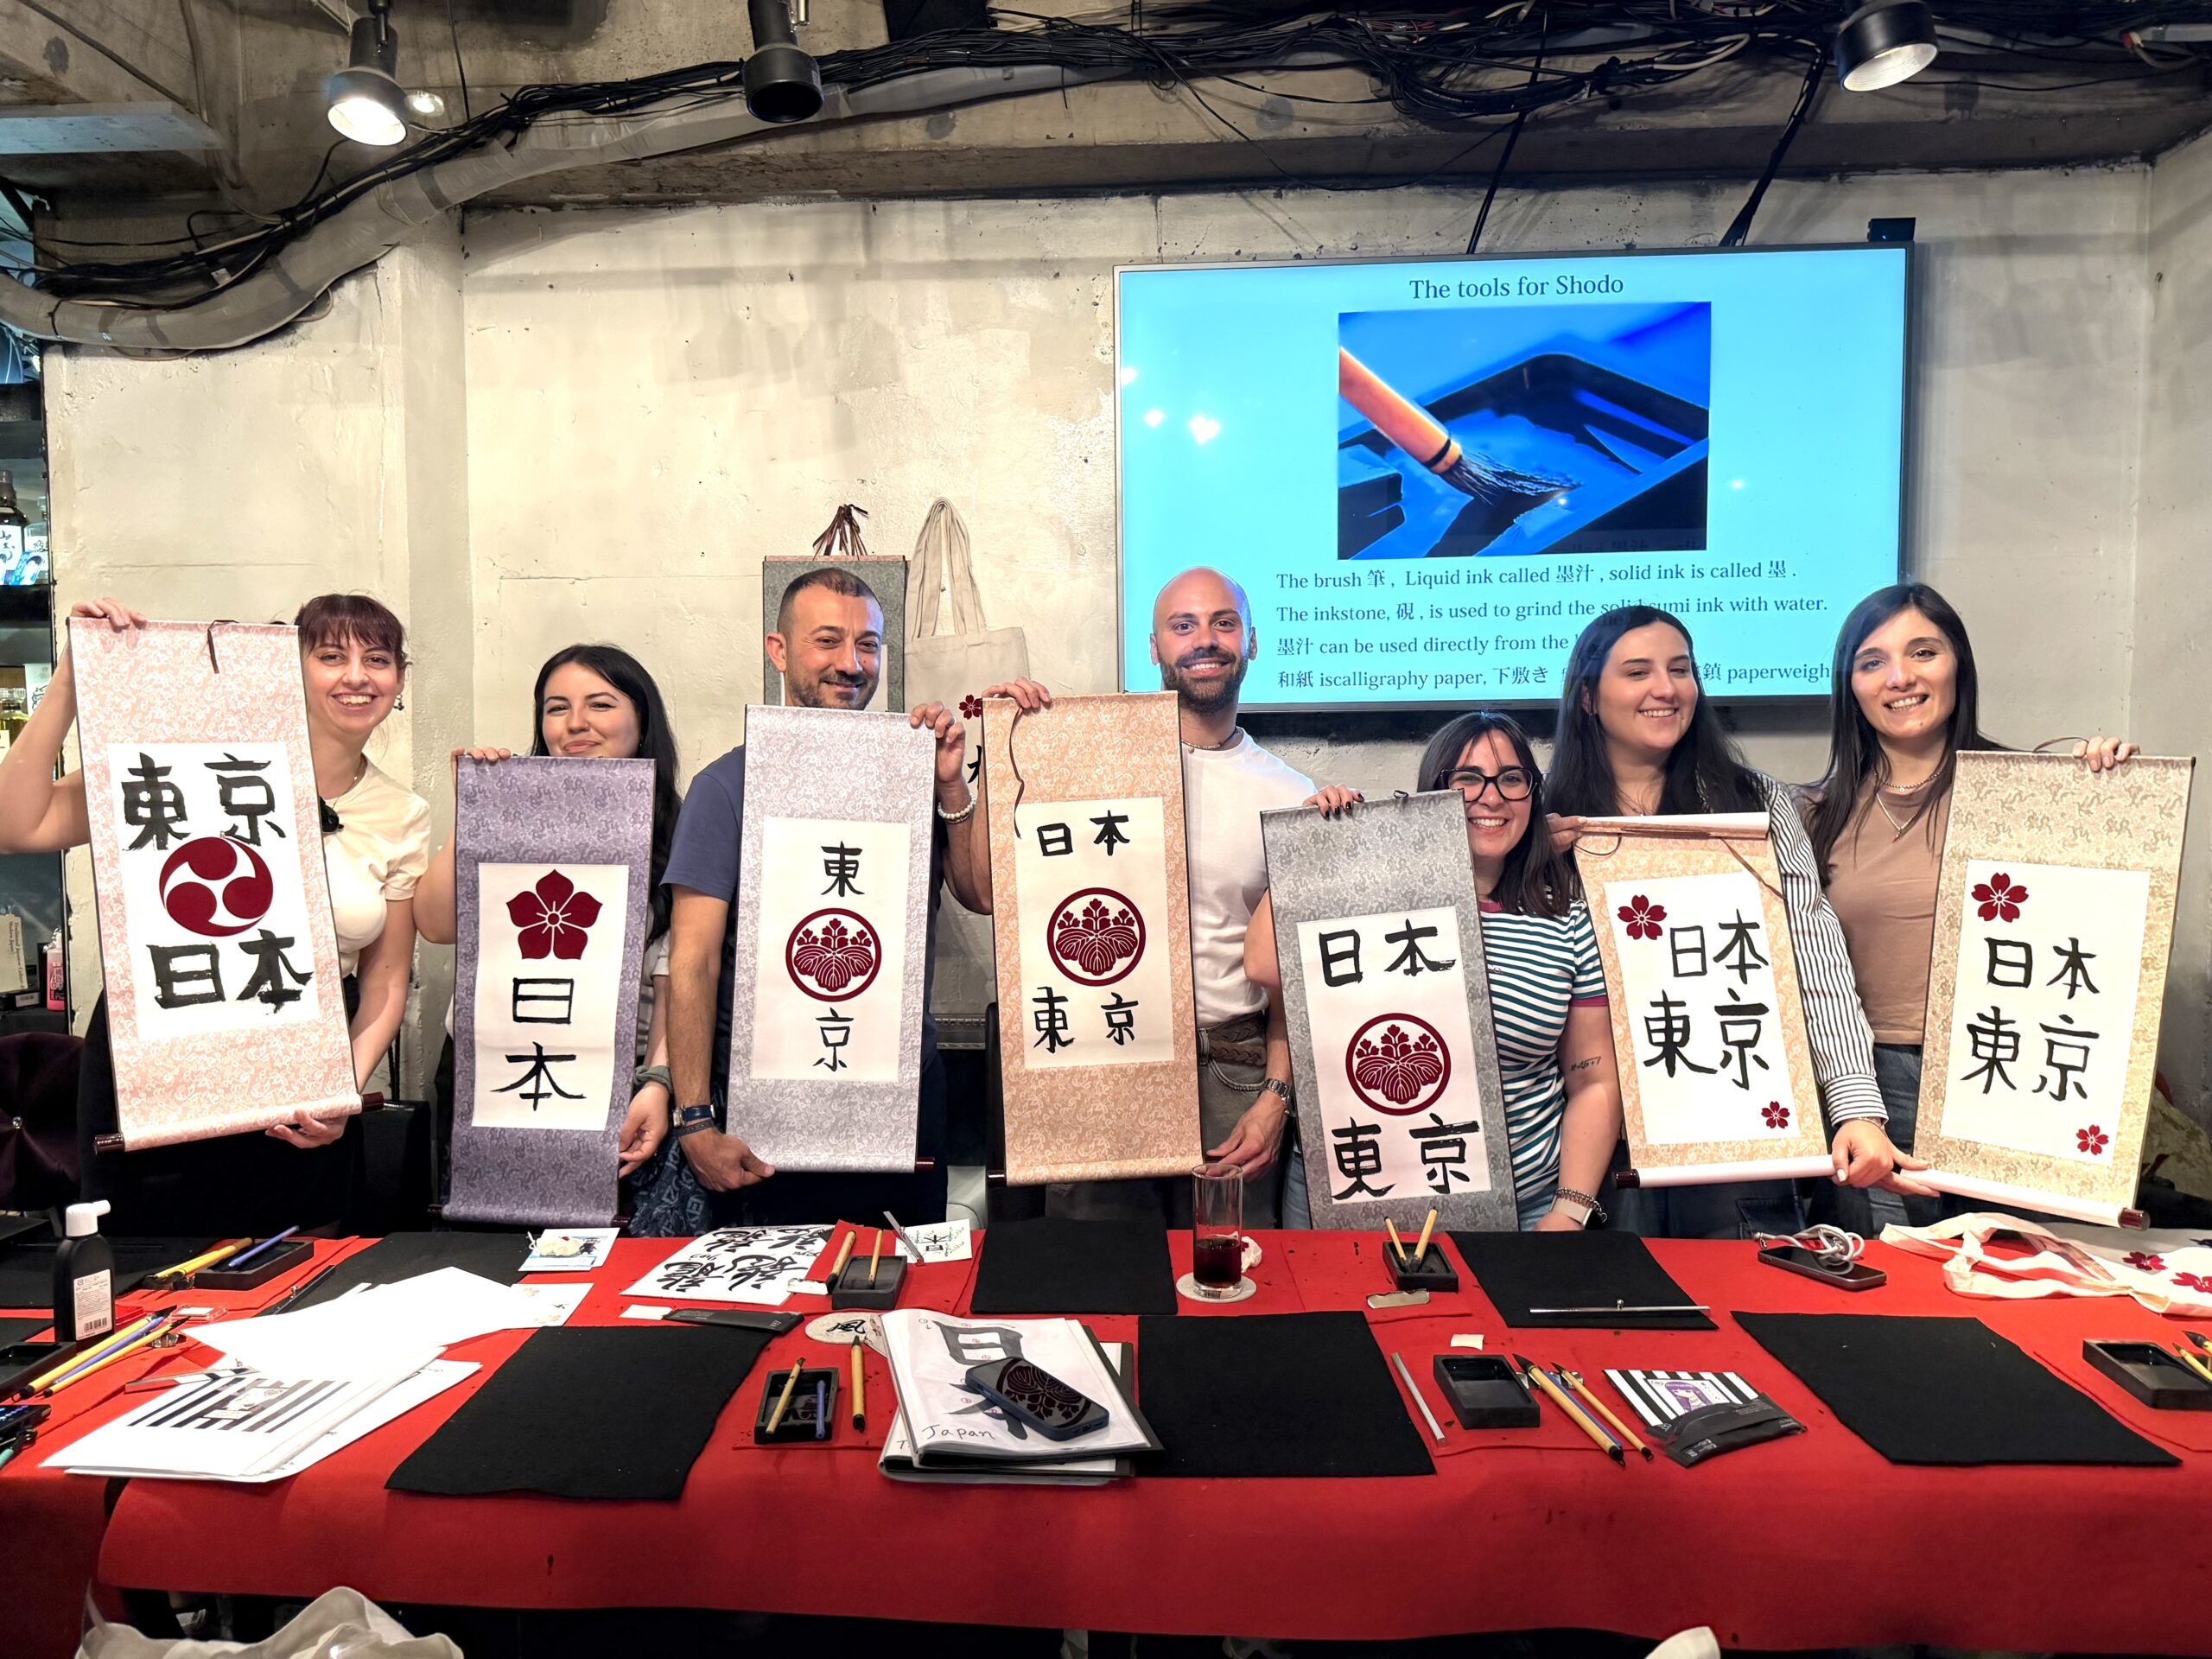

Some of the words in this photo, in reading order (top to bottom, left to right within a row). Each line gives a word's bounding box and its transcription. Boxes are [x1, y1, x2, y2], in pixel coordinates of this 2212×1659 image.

[1409, 280, 1450, 298] The
[1459, 277, 1510, 297] tools
[1518, 276, 1549, 296] for
[1556, 275, 1623, 295] Shodo
[1276, 574, 1308, 588] The
[1314, 572, 1361, 588] brush
[1406, 569, 1459, 589] Liquid
[1466, 569, 1493, 583] ink
[1499, 568, 1549, 583] called
[1610, 565, 1650, 580] solid
[1657, 564, 1684, 579] ink
[1691, 564, 1704, 578] is
[1711, 563, 1761, 578] called
[1276, 607, 1308, 621] The
[1314, 607, 1389, 621] inkstone,
[1430, 605, 1443, 618] is
[1449, 603, 1487, 618] used
[1494, 604, 1510, 617] to
[1516, 601, 1561, 621] grind
[1569, 601, 1594, 614] the
[1697, 597, 1723, 612] ink
[1730, 596, 1767, 611] with
[1774, 598, 1827, 610] water.
[1278, 638, 1313, 655] 墨汁
[1320, 643, 1348, 653] can
[1355, 639, 1373, 652] be
[1380, 638, 1417, 652] used
[1424, 636, 1489, 655] directly
[1495, 635, 1535, 650] from
[1542, 634, 1568, 649] the
[1278, 671, 1313, 688] 和紙
[1434, 674, 1486, 689] paper,
[1493, 666, 1548, 684] 下敷き
[1727, 664, 1830, 683] paperweigh
[122, 752, 286, 850] 東京
[1037, 810, 1129, 856] 日本
[147, 929, 315, 1015] 日本
[1319, 919, 1455, 987] 日本
[1670, 909, 1768, 984] 日本
[1985, 938, 2099, 999] 日本
[1033, 983, 1138, 1053] 東京
[1643, 988, 1769, 1090] 東京
[1961, 1007, 2099, 1101] 東京
[1332, 1113, 1480, 1199] 東京
[922, 1424, 996, 1440] Japan
